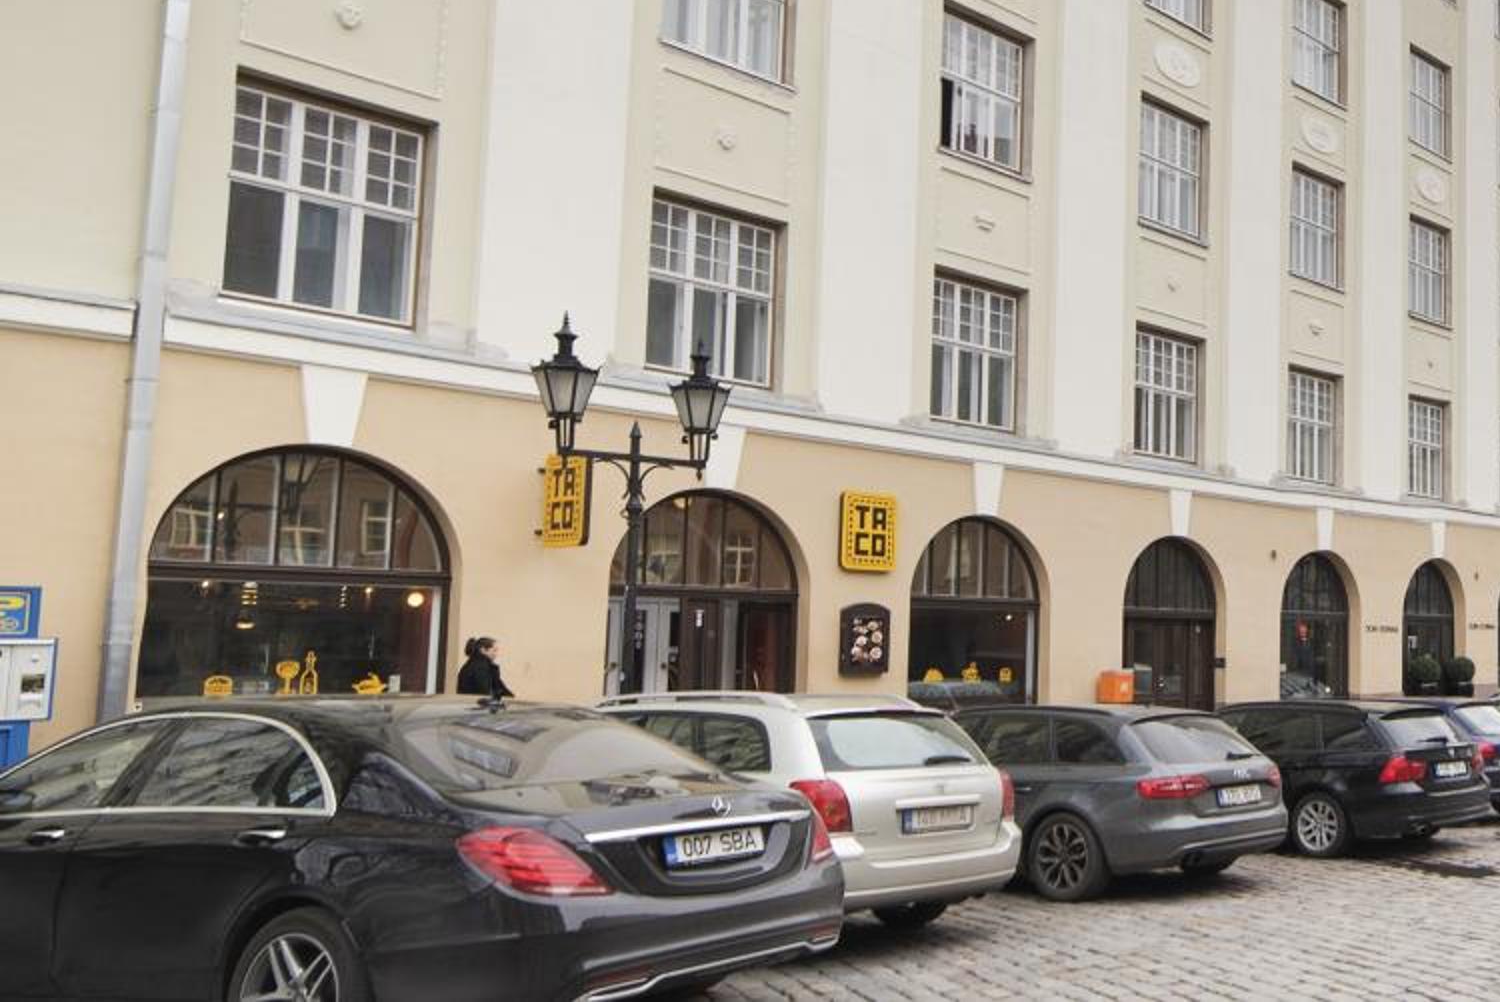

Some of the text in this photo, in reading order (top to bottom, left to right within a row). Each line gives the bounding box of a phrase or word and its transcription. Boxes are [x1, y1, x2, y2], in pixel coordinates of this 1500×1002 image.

[553, 468, 575, 497] TA
[550, 501, 574, 528] CO
[855, 505, 888, 530] TA
[854, 532, 887, 557] CO
[682, 829, 757, 857] 007 SBA
